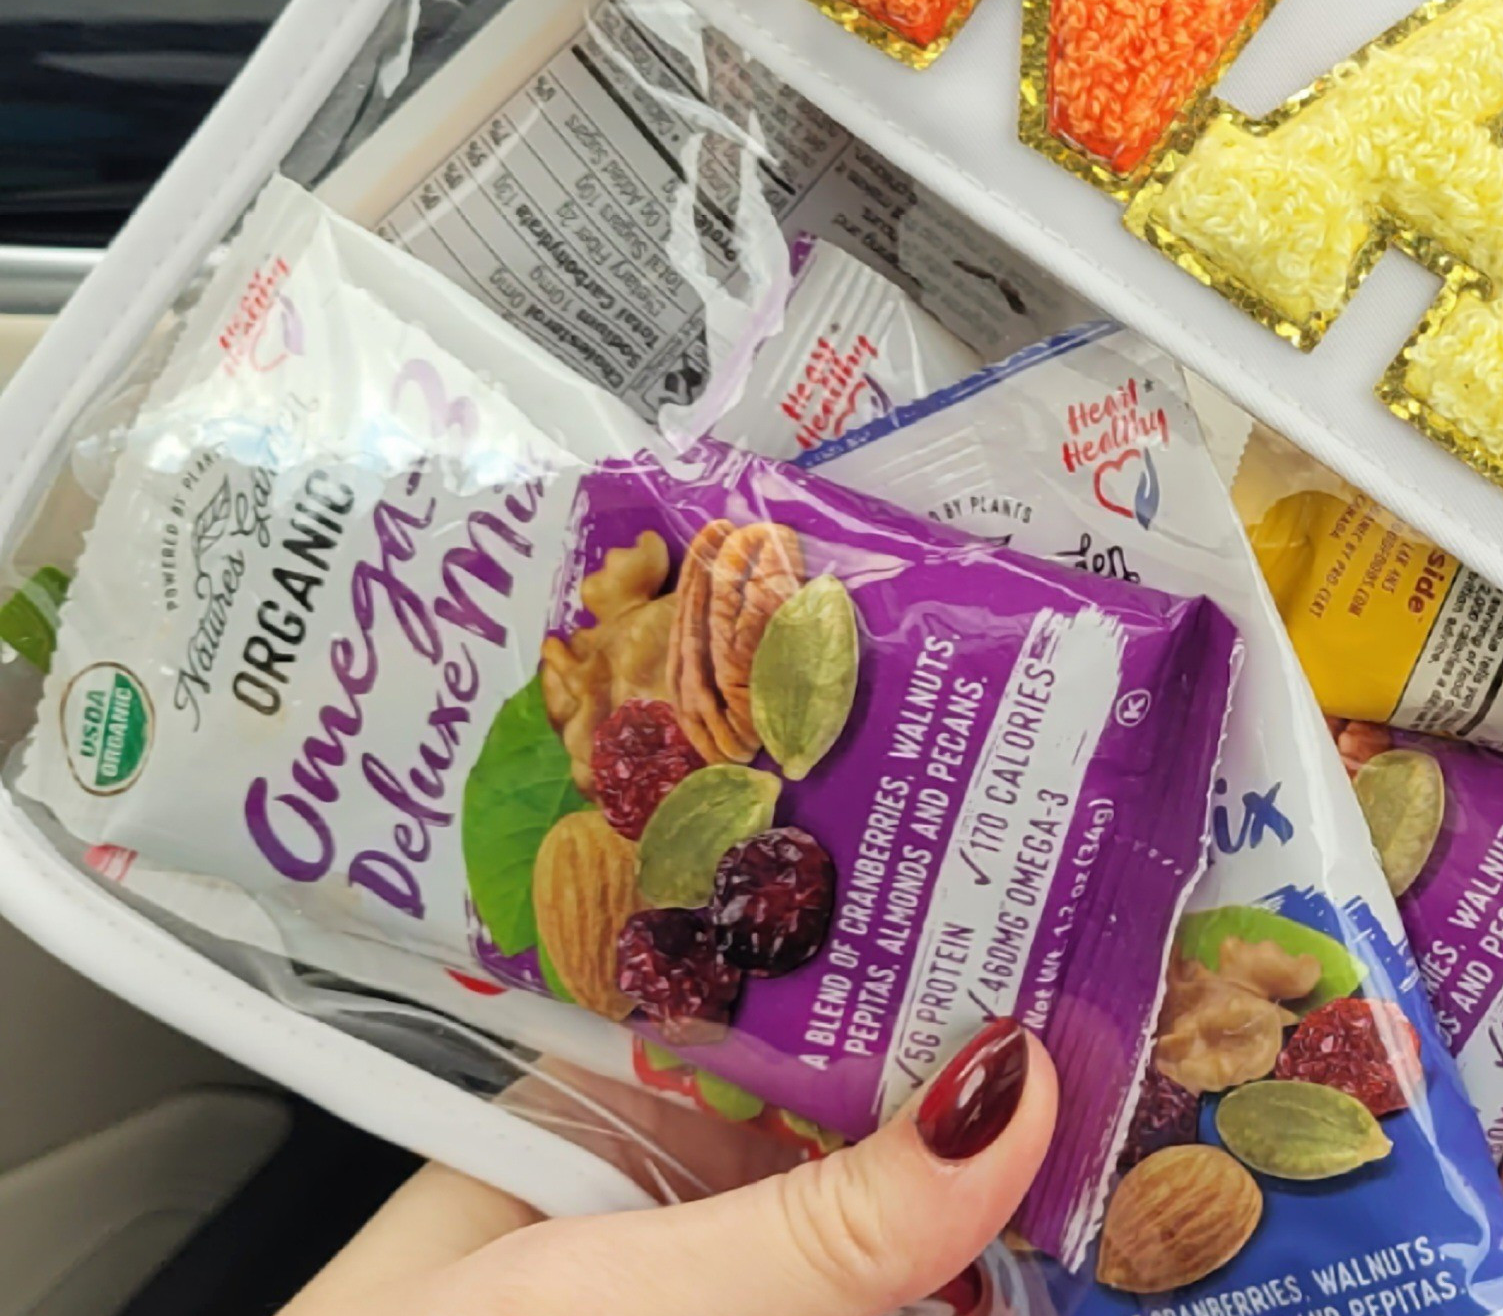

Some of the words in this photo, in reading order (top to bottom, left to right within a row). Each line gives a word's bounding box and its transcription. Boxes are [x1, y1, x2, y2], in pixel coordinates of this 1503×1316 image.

[603, 158, 643, 205] Added
[514, 202, 617, 312] Carbohydrate
[571, 222, 613, 265] Fiber
[595, 201, 649, 260] Sugars
[644, 253, 687, 296] Total
[523, 303, 625, 388] Cholesterol
[574, 307, 643, 368] Sodium
[614, 306, 659, 349] Total
[1060, 406, 1169, 473] Healthy
[1067, 376, 1142, 434] Heart
[965, 495, 1030, 522] PLANTS
[226, 466, 359, 719] ORGANIC
[74, 686, 107, 757] USDA
[98, 684, 134, 777] ORGANIC
[924, 666, 991, 784] PECANS.
[981, 659, 1059, 805] CALORIES
[342, 642, 482, 917] Deluxe
[908, 784, 951, 840] AND
[834, 764, 920, 937] CRANBERRIES,
[964, 806, 1012, 859] 170
[1002, 783, 1071, 907] OMEGA-3
[1214, 782, 1293, 853] ix
[872, 842, 937, 954] ALMONDS
[829, 938, 862, 970] OF
[912, 917, 976, 1026] PROTEIN
[976, 906, 1033, 994] 460MG
[806, 972, 856, 1047] BLEND
[1016, 982, 1056, 1030] Net
[1448, 957, 1498, 1014] AND
[796, 1045, 832, 1074] A
